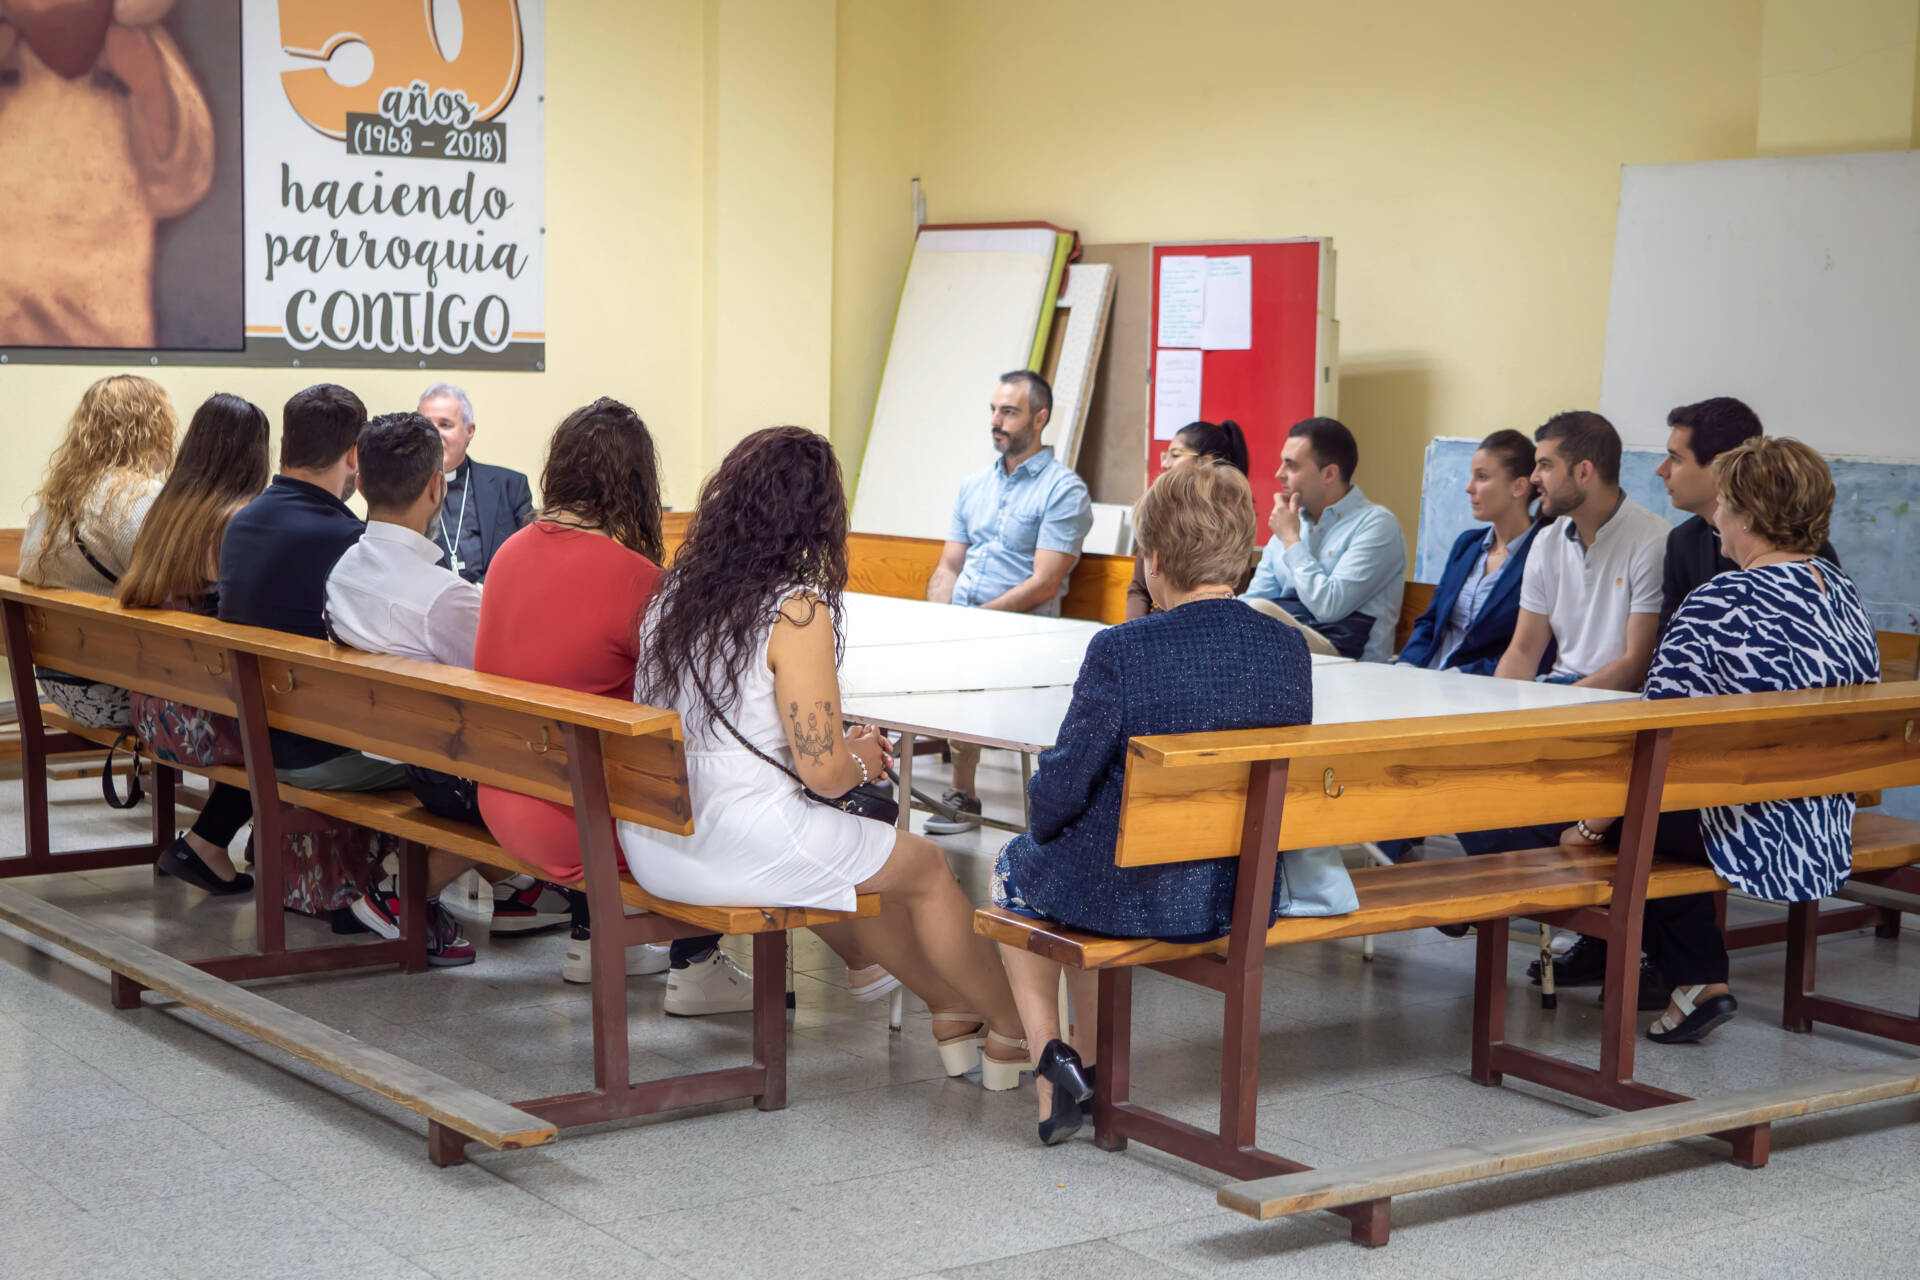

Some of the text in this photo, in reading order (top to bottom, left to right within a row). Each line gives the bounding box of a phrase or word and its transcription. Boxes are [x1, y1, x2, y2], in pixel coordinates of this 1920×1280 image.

[382, 84, 476, 124] años
[354, 121, 413, 155] (1968
[443, 130, 502, 163] 2018)
[281, 162, 514, 225] haciendo
[265, 229, 529, 289] parroquia
[285, 289, 511, 348] CONTIGO
